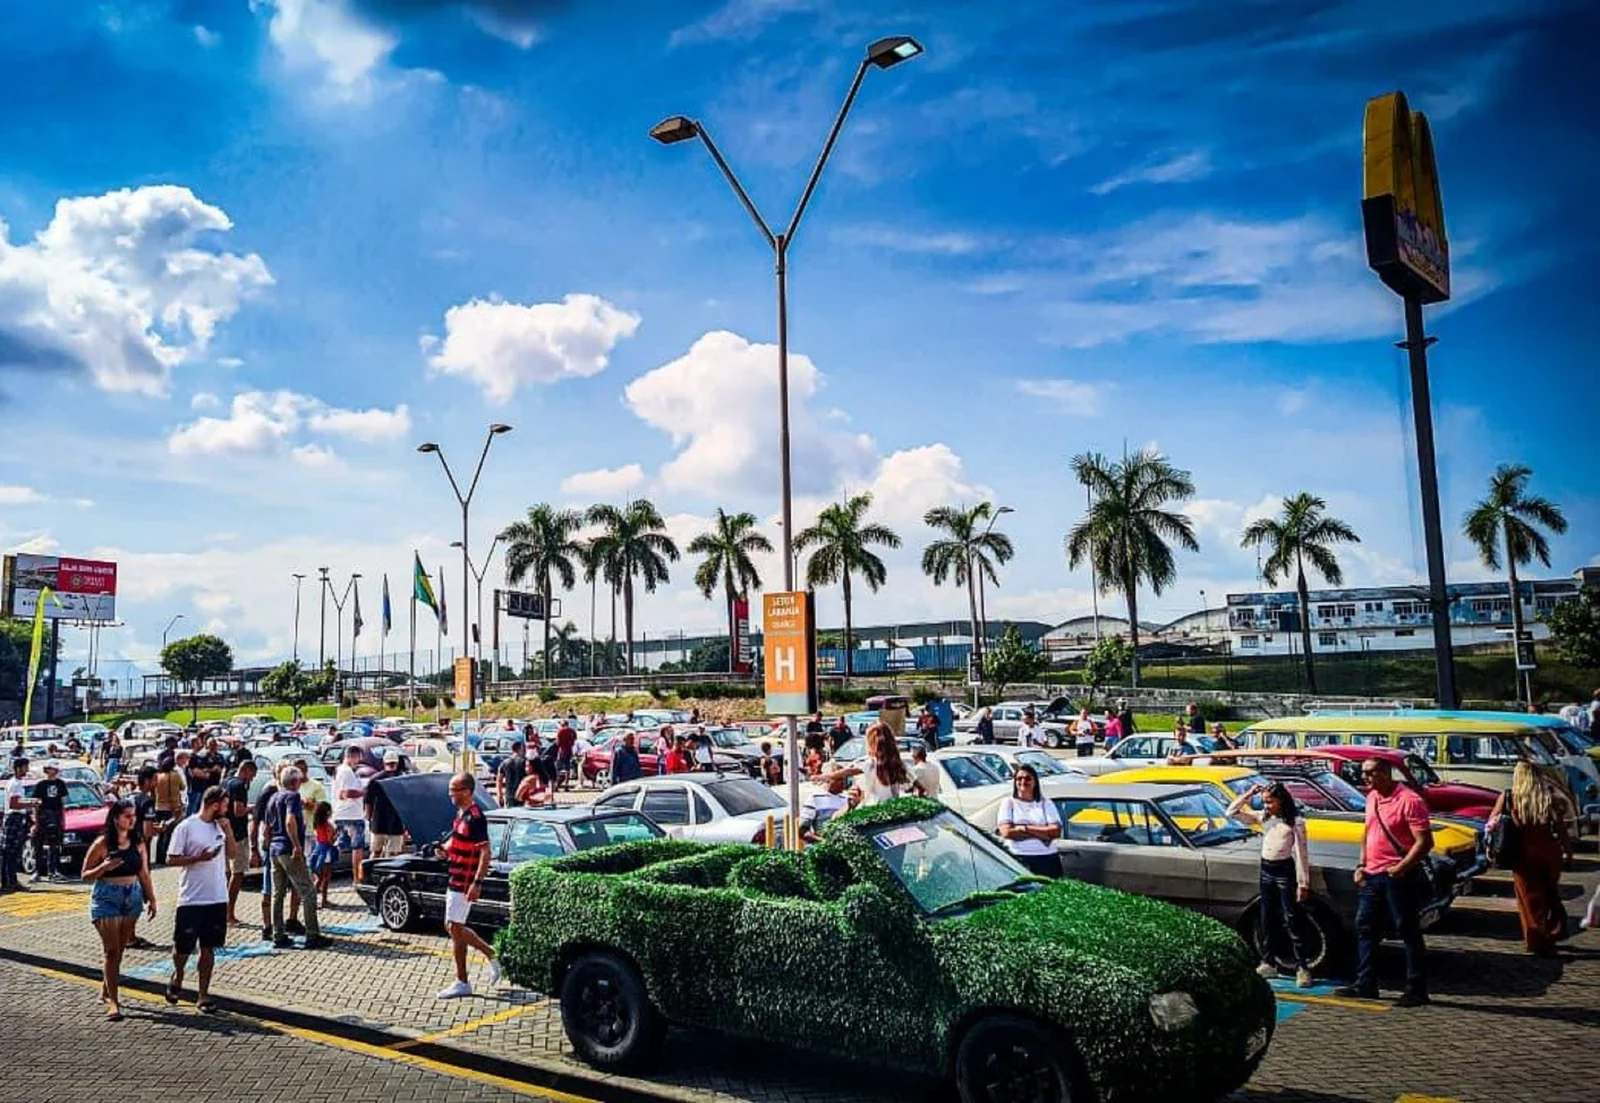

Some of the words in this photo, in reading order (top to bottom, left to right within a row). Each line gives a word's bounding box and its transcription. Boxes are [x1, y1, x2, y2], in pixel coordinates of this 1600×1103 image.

[773, 597, 795, 606] SETOR
[768, 608, 799, 617] LARANJA
[776, 647, 795, 681] H
[459, 680, 466, 696] G
